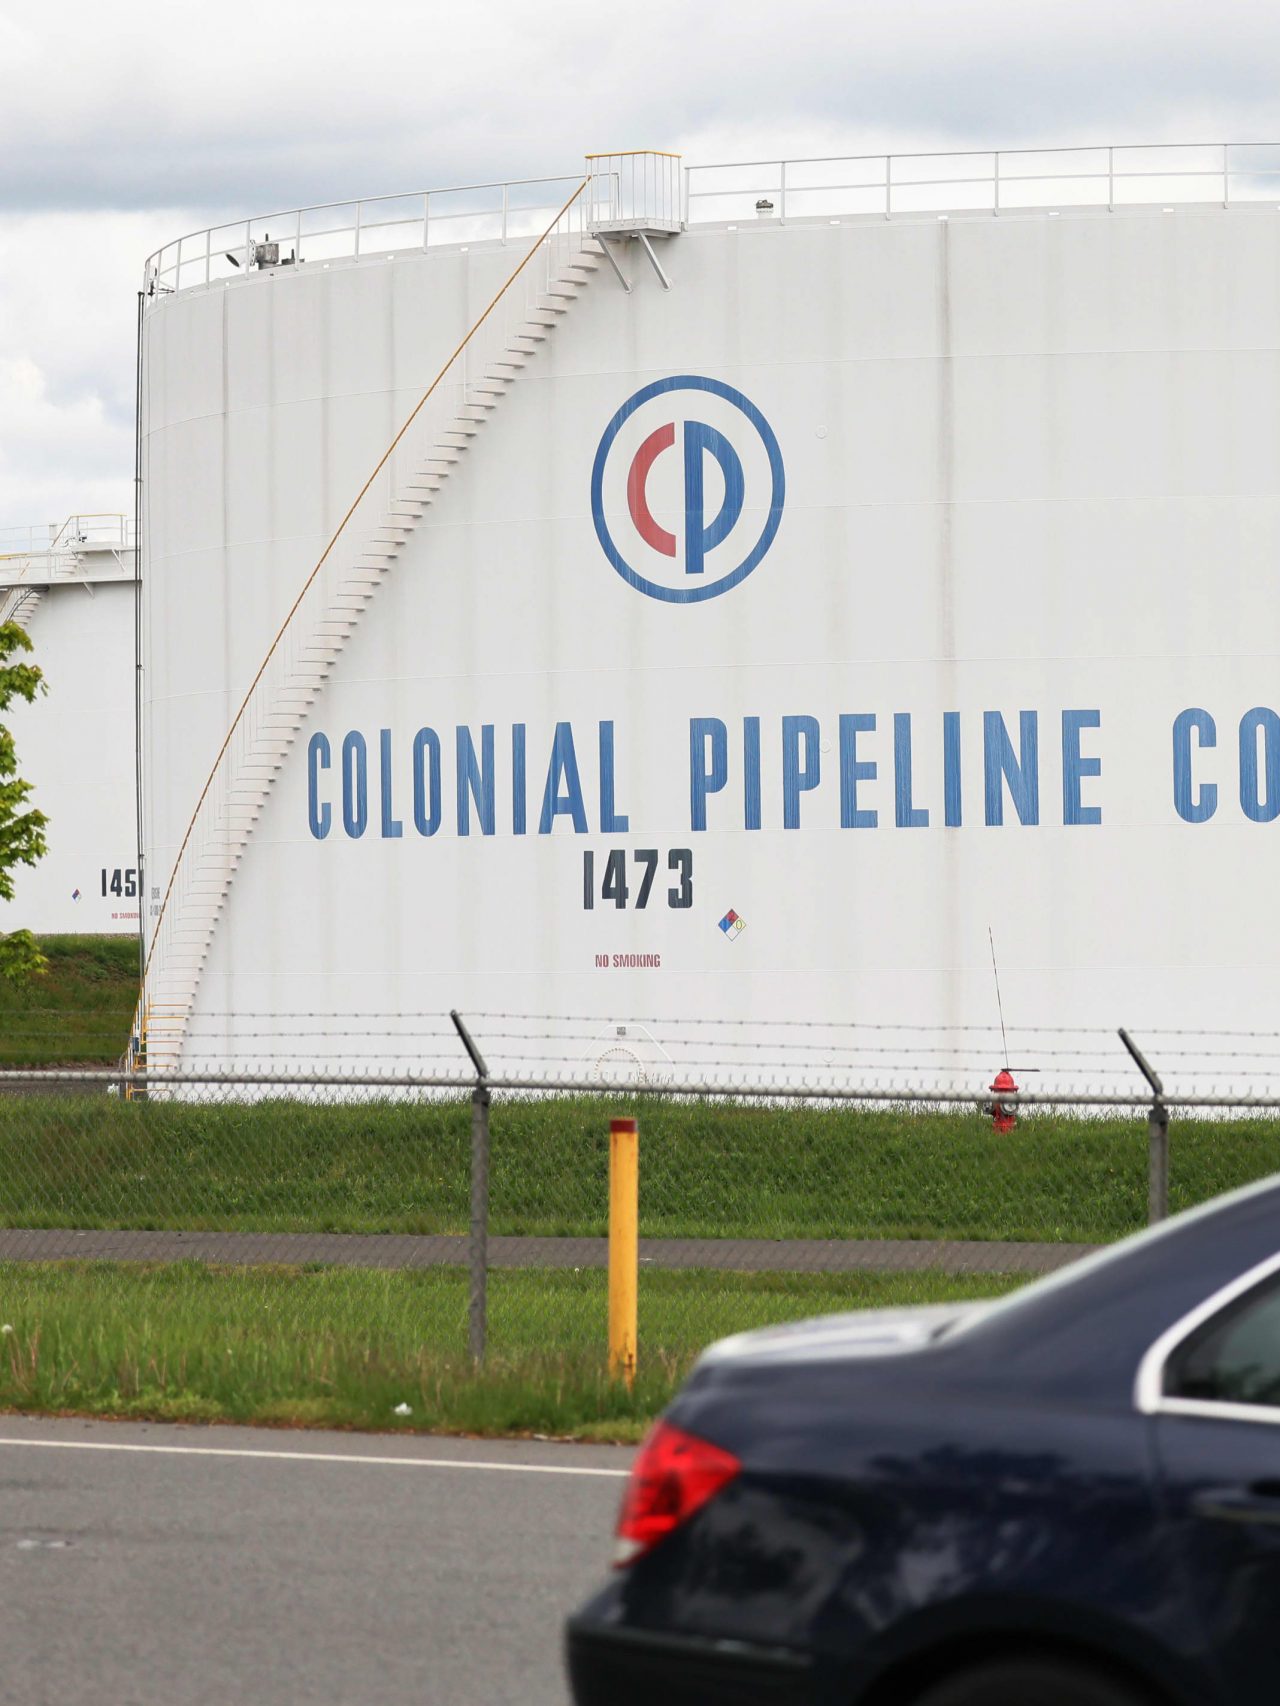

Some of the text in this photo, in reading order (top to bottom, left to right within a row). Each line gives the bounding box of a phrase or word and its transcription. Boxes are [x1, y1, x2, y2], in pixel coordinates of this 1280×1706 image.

[308, 720, 629, 840] COLONIAL
[689, 709, 1102, 832] PIPELINE
[583, 848, 693, 910] 1473
[595, 954, 661, 968] NO SMOKING
